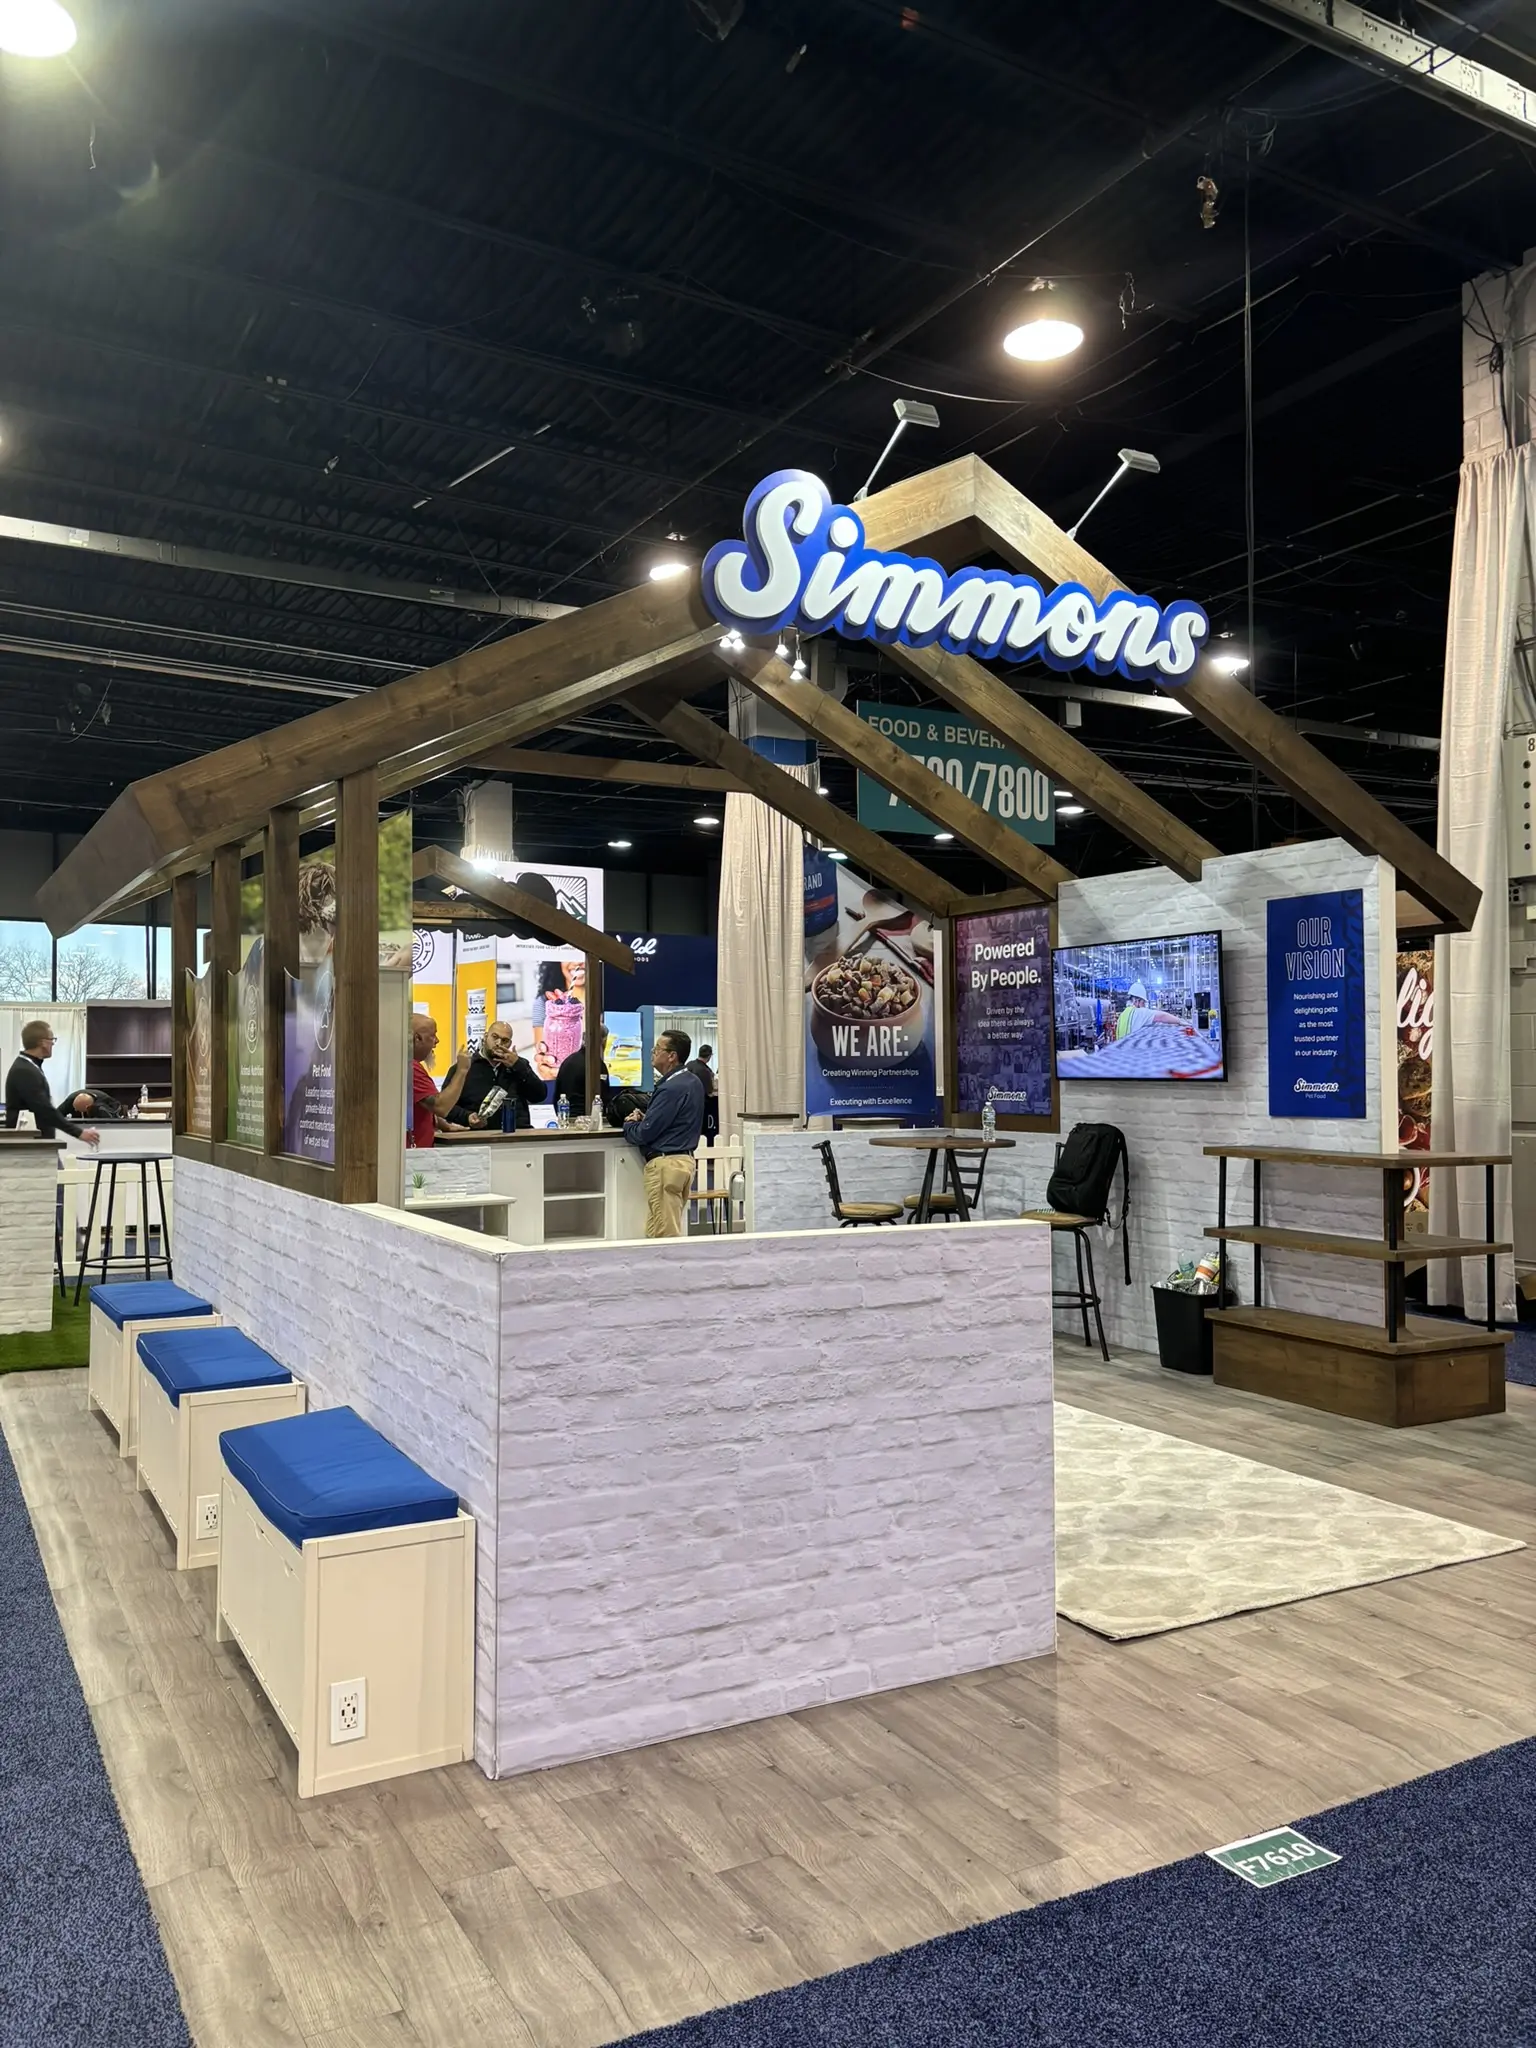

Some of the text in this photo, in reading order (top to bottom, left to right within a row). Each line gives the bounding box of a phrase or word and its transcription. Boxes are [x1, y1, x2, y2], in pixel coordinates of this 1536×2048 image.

[712, 480, 1207, 676] Simmons
[926, 723, 939, 742] &
[804, 872, 823, 891] RAND
[1297, 916, 1332, 948] OUR
[974, 937, 1035, 961] Powered
[1285, 948, 1345, 981] VISION
[971, 966, 1042, 992] By People.
[1293, 991, 1339, 1000] Nourishing and
[985, 1006, 1025, 1016] Driven by the
[1294, 1005, 1339, 1015] delighting pets
[977, 1018, 1035, 1028] idea there is always
[1317, 1020, 1334, 1028] most
[831, 1025, 909, 1057] WE ARE:
[991, 1031, 1010, 1039] better
[1010, 1031, 1024, 1040] way.
[1316, 1034, 1339, 1043] partner
[1312, 1049, 1339, 1057] industry.
[312, 1064, 332, 1077] Pet Food
[822, 1068, 919, 1077] Creating Winning Partnerships
[1293, 1077, 1340, 1092] Simmons
[986, 1085, 1027, 1101] Simmons
[829, 1096, 913, 1107] Executing with Excellence
[1235, 1842, 1316, 1876] F7610
